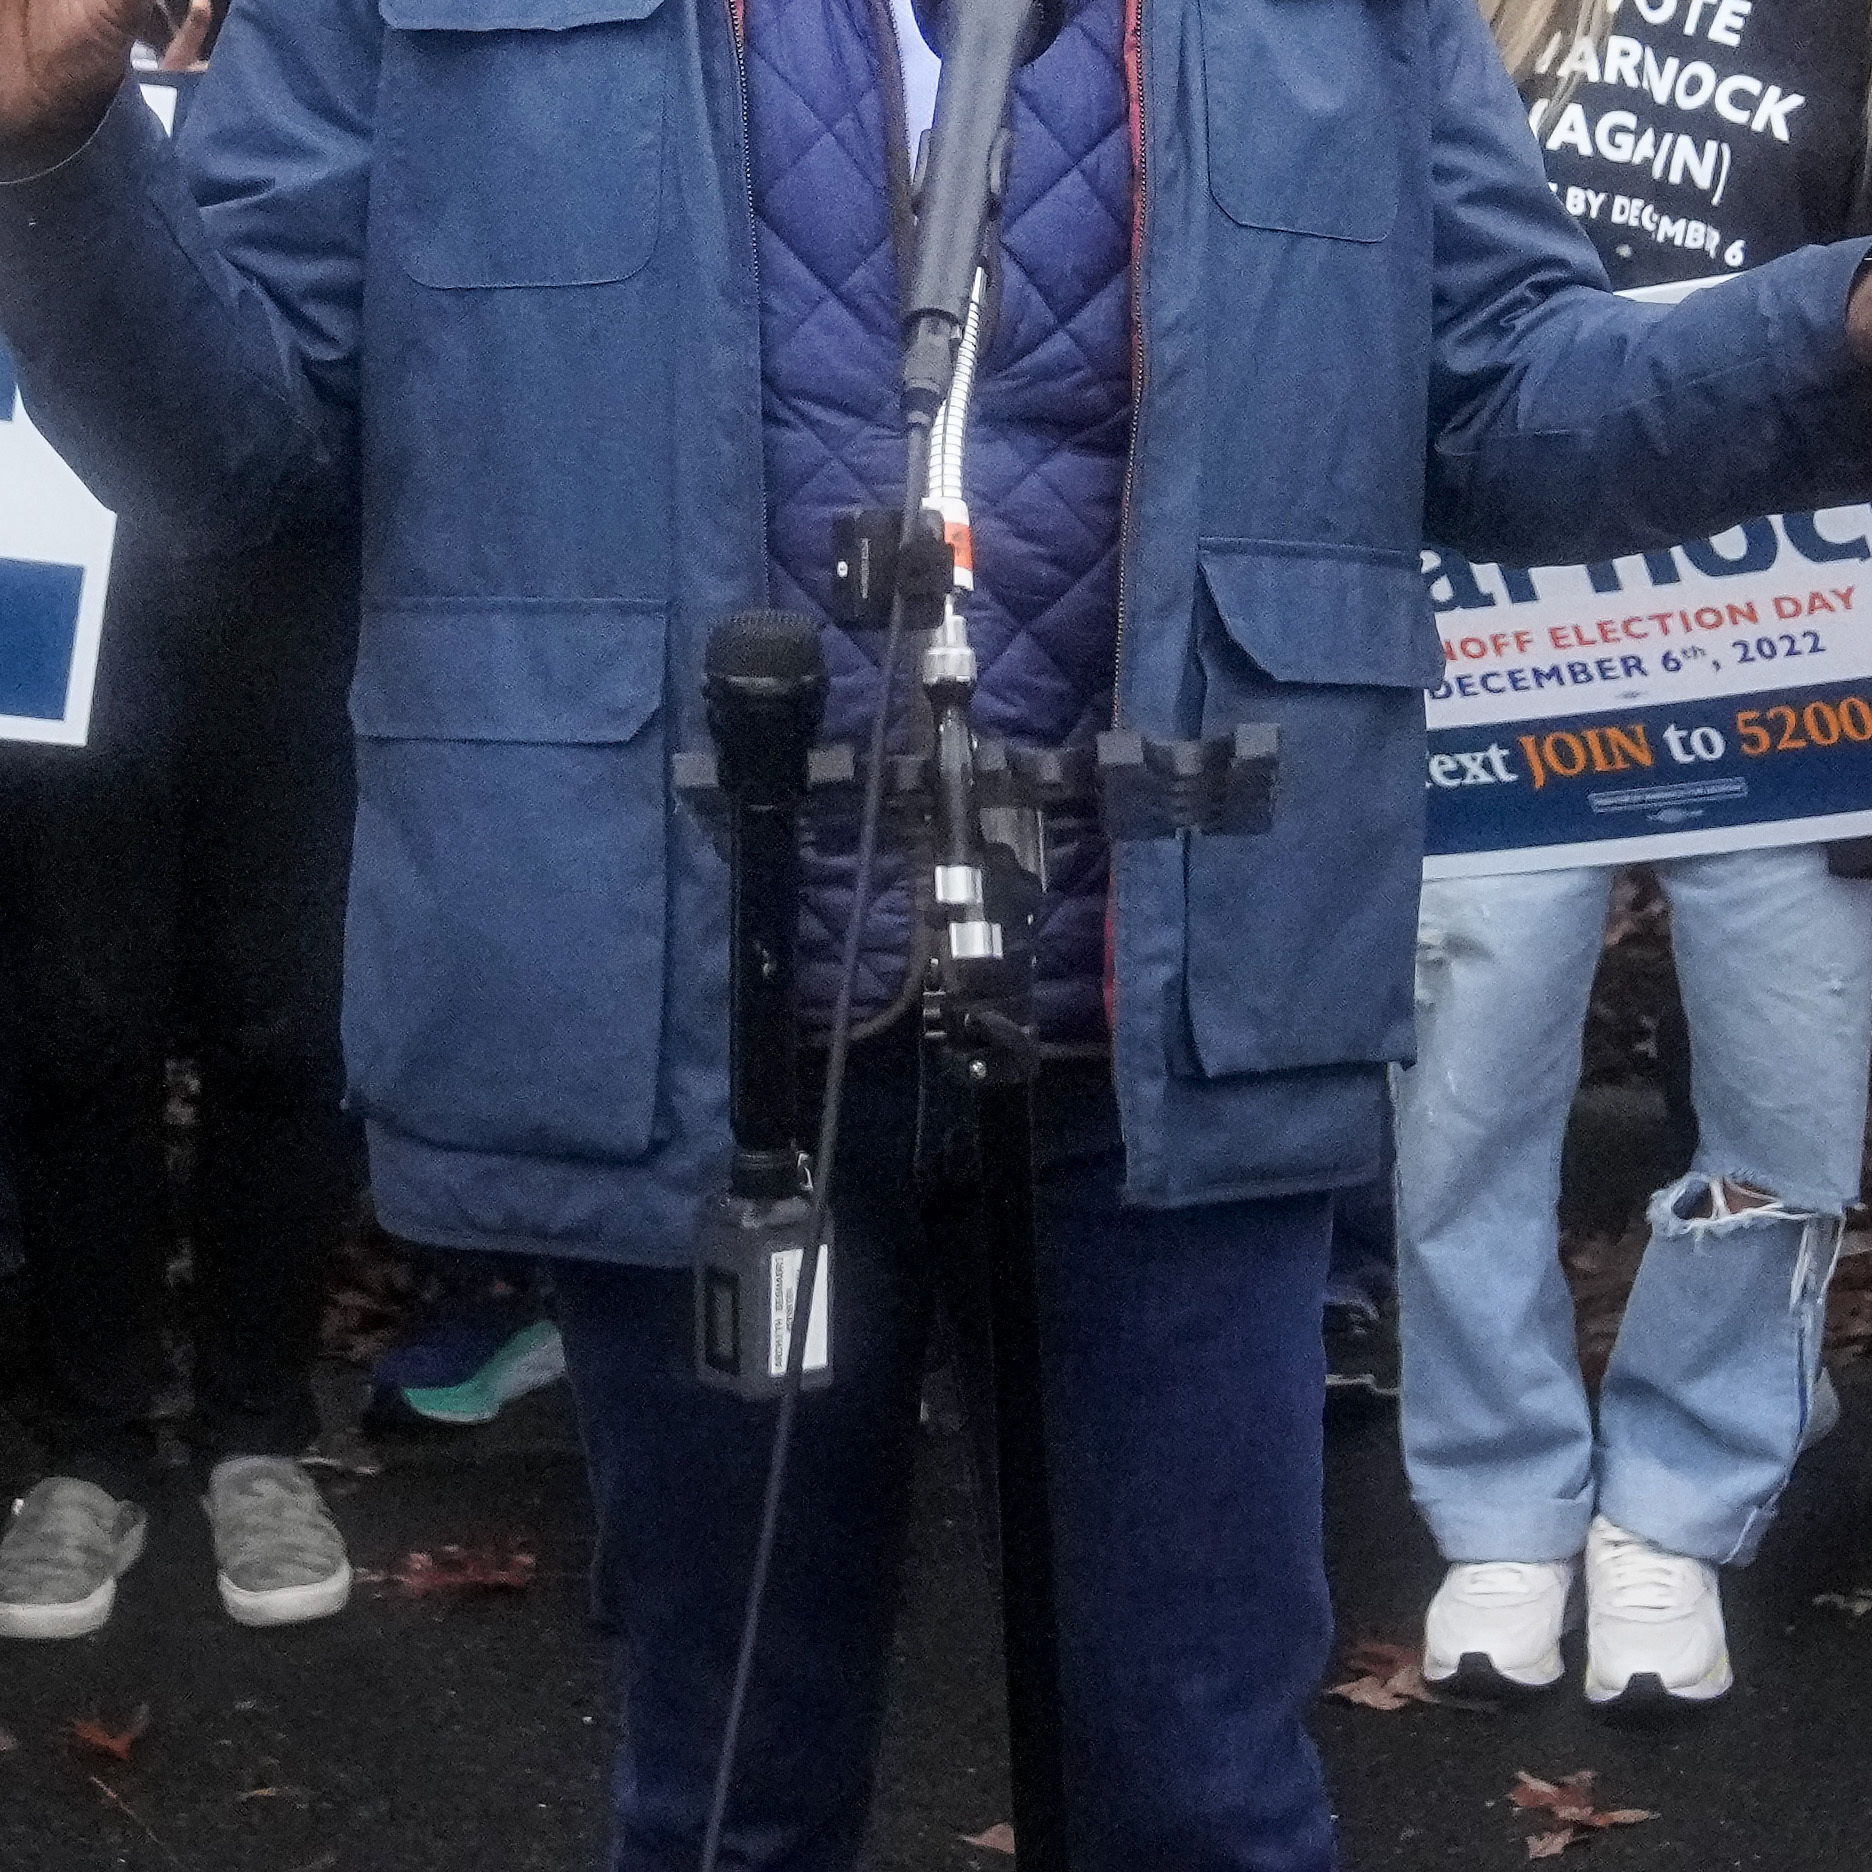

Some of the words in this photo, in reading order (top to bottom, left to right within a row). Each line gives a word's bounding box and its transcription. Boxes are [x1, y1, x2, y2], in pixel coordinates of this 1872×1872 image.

[1534, 30, 1806, 143] ARNOCK
[1565, 185, 1606, 220] BY
[1724, 238, 1747, 267] 6
[1442, 631, 1534, 663] NOFF
[1549, 599, 1760, 653] ELECTION
[1772, 584, 1859, 622] DAY
[1431, 653, 1649, 701] DECEMBER
[1662, 643, 1722, 677] 6th,
[1730, 629, 1827, 666] 2022
[1426, 739, 1518, 789] ext
[1518, 722, 1656, 791] JOIN
[1662, 719, 1726, 766] to
